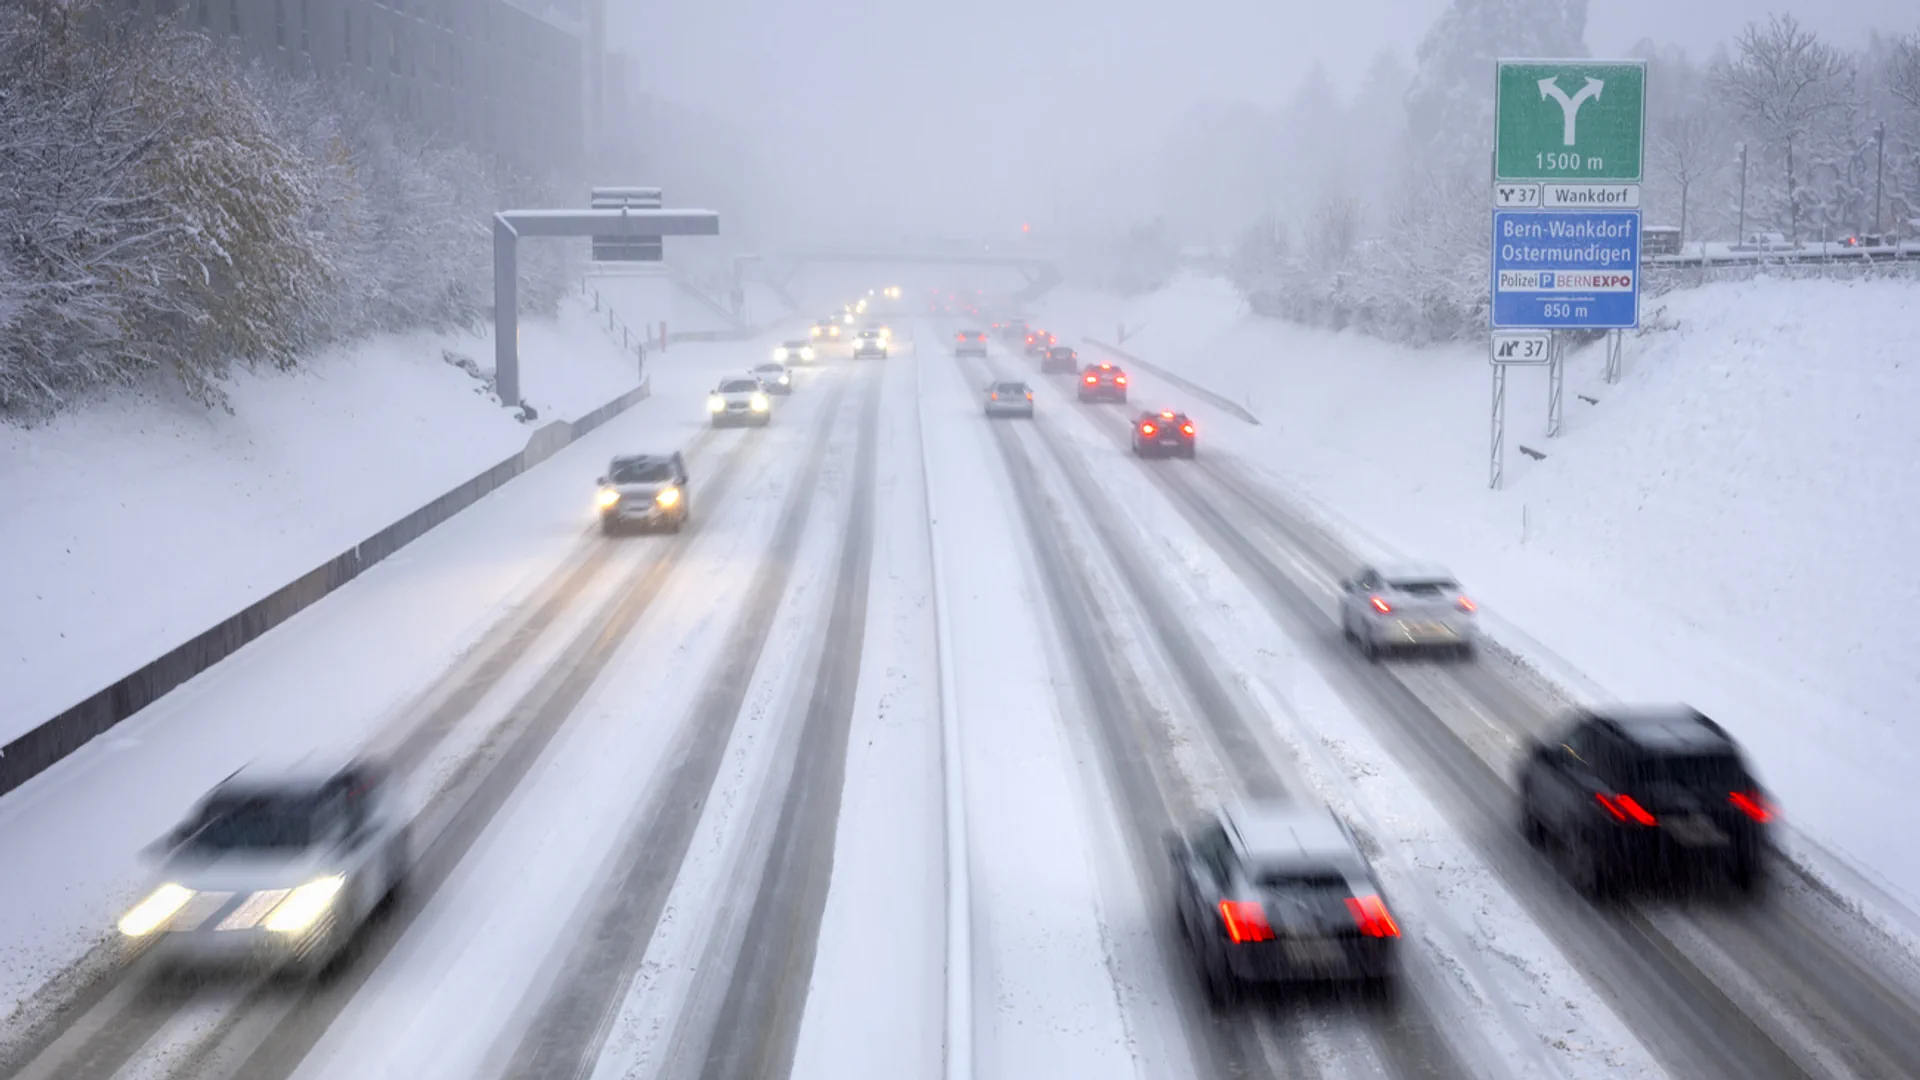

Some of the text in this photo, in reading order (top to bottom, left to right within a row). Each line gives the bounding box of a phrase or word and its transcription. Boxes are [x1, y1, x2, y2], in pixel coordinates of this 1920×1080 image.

[1536, 153, 1603, 170] 1500 m
[1518, 189, 1536, 202] 37
[1555, 189, 1628, 202] Wankdorf
[1503, 220, 1631, 238] Bern-Wankdorf
[1502, 244, 1631, 266] Ostermundigen
[1500, 273, 1538, 287] Polizei
[1557, 275, 1631, 288] BERNEXPO
[1544, 304, 1588, 318] 850 m
[1524, 341, 1543, 357] 37
